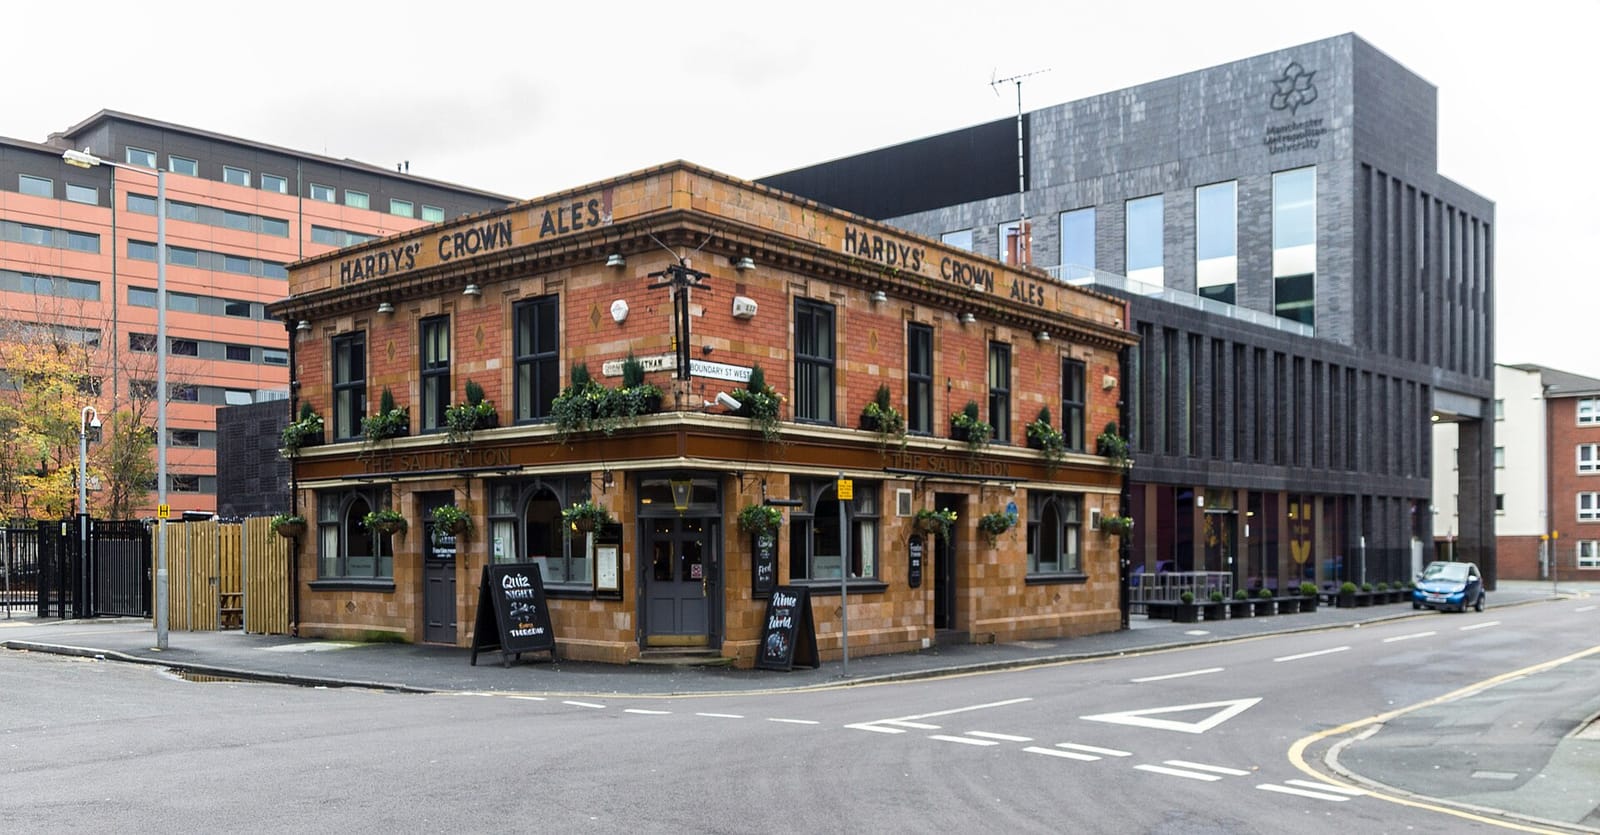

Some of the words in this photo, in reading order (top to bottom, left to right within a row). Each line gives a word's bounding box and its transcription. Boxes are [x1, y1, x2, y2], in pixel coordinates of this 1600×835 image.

[438, 218, 513, 261] CROWN
[539, 199, 600, 238] ALES
[940, 257, 994, 293] CROWN
[1010, 276, 1045, 307] ALES
[690, 362, 723, 375] BOUNDARY
[725, 367, 732, 377] ST
[734, 368, 750, 379] WEST
[362, 457, 393, 473] THE
[400, 449, 511, 471] SALUTATION
[893, 454, 921, 471] THE
[928, 455, 1009, 477] SALUTATION
[502, 573, 530, 589] Quiz
[505, 588, 534, 600] NIGHT
[772, 591, 797, 608] Wines
